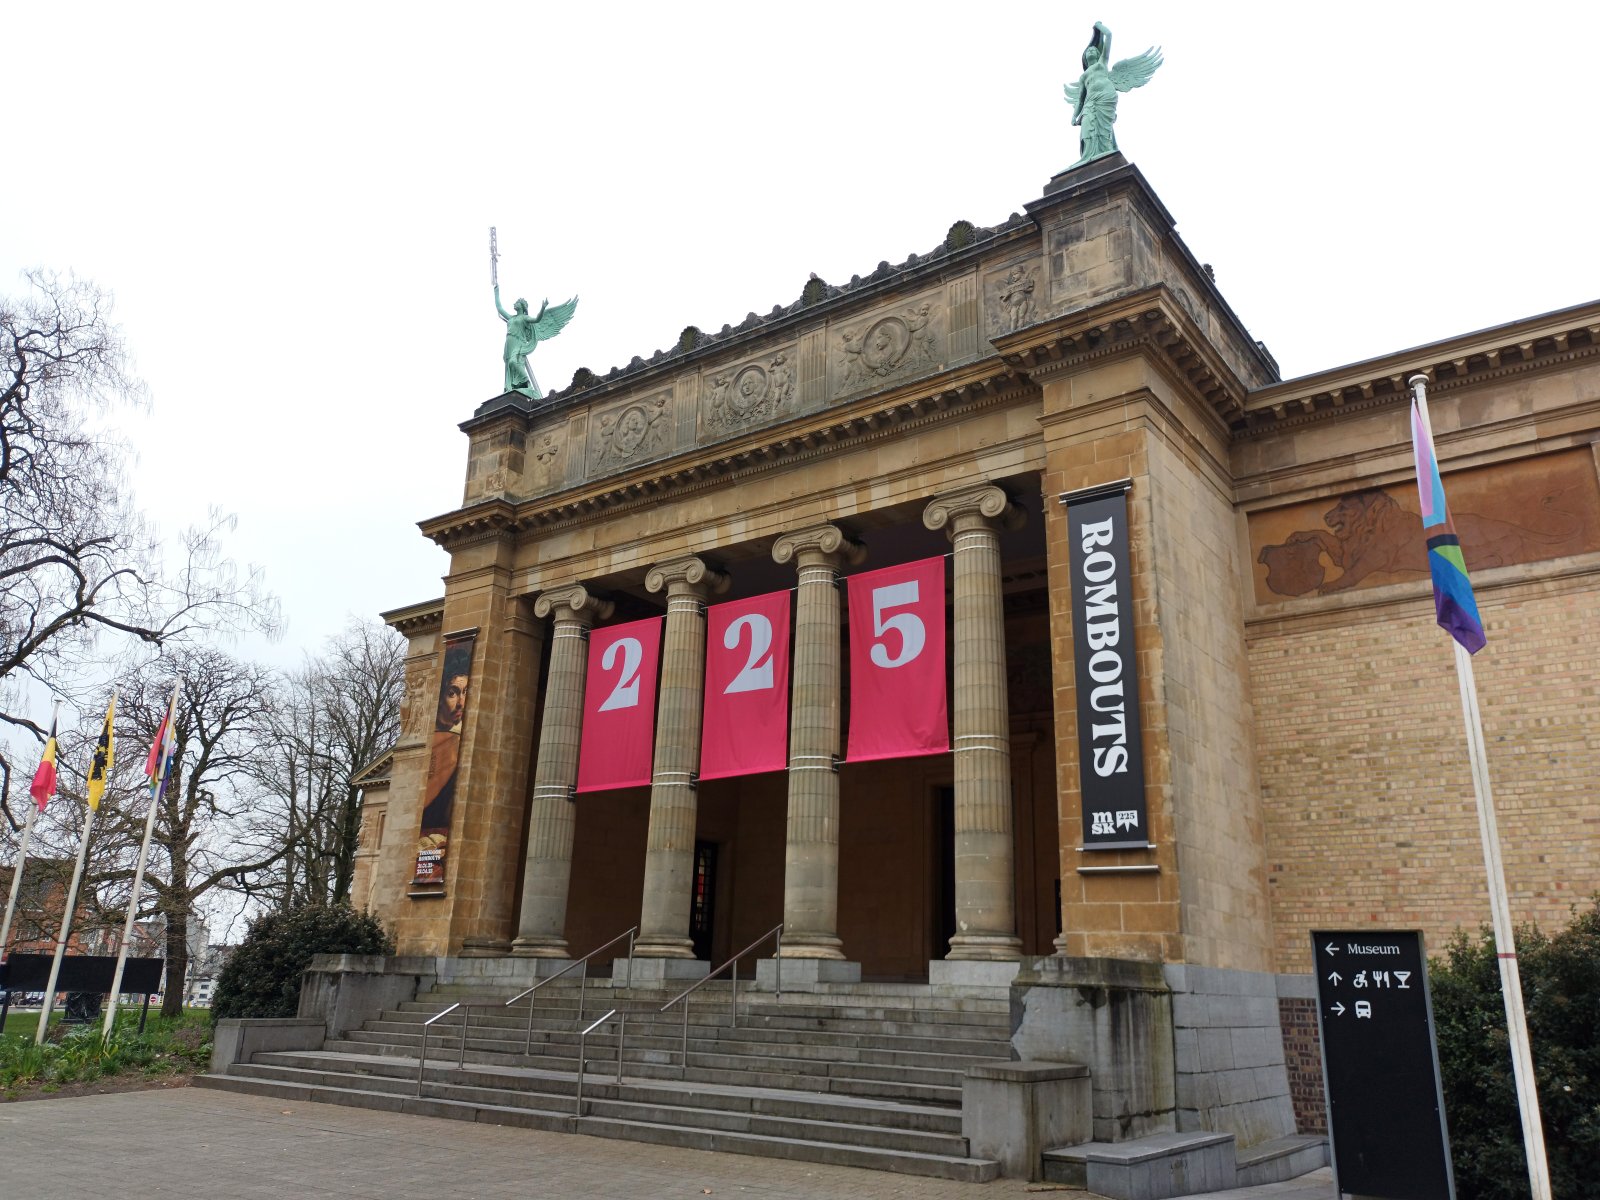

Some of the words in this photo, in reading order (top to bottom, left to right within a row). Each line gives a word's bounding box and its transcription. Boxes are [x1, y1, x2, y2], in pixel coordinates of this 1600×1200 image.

[599, 638, 642, 711] 2
[724, 614, 773, 693] 2
[871, 580, 925, 668] 5
[1081, 516, 1128, 778] ROMBOUTS
[1119, 812, 1135, 820] 225
[1348, 944, 1399, 955] Museum
